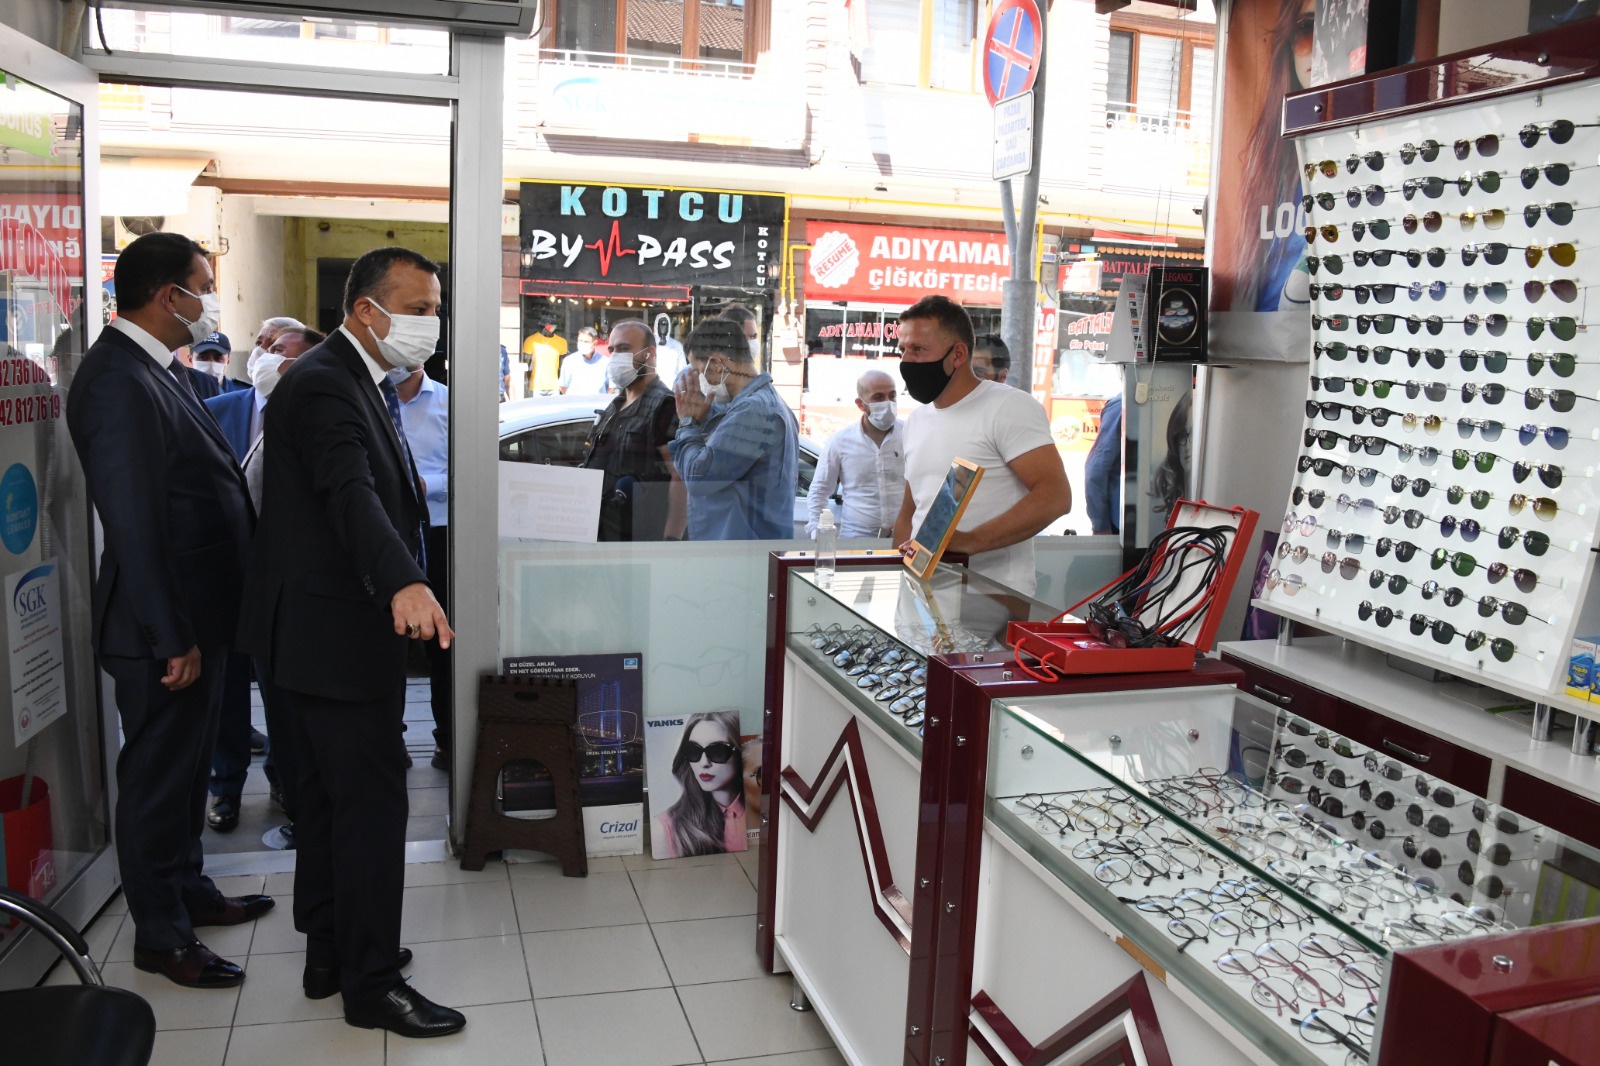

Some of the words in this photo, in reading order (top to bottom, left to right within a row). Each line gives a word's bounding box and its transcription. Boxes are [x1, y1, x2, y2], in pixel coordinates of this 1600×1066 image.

[560, 185, 743, 223] KOTCU
[532, 229, 584, 268] BY
[637, 233, 736, 270] PASS
[756, 226, 770, 287] KOTCU
[814, 238, 853, 278] RESUME
[818, 322, 882, 339] ADIYAMAN
[11, 358, 30, 386] 736
[15, 396, 34, 425] 812
[35, 394, 47, 422] 76
[49, 393, 61, 420] 19
[19, 583, 47, 617] SGK
[647, 718, 684, 728] YANKS
[600, 819, 638, 834] Crizal
